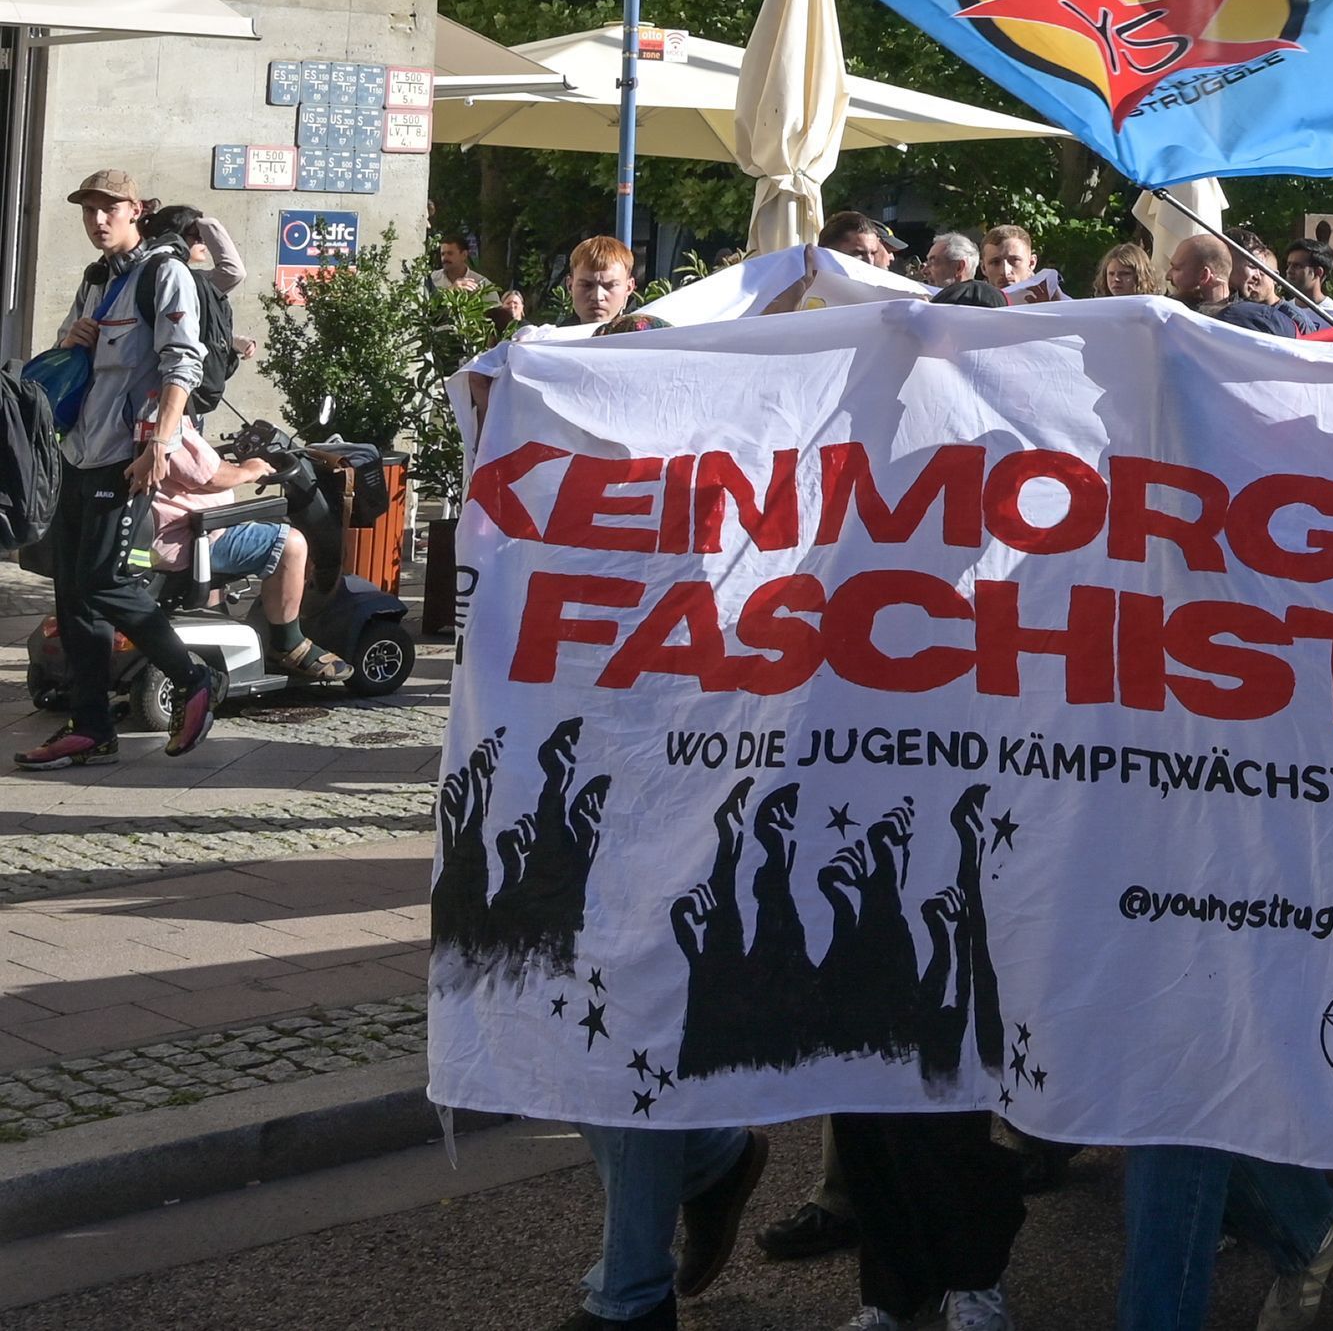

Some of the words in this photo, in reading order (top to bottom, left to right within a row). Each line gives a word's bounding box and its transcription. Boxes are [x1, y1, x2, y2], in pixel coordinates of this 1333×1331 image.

[1058, 0, 1193, 75] YS
[274, 70, 286, 80] ES
[304, 70, 317, 80] ES
[332, 72, 344, 82] ES
[359, 74, 366, 83] S
[392, 73, 399, 81] H
[405, 73, 422, 82] 500
[302, 113, 314, 123] US
[331, 114, 343, 125] US
[357, 116, 364, 126] S
[390, 116, 397, 124] H
[403, 115, 420, 124] 500
[253, 151, 260, 159] H
[265, 151, 283, 160] 500
[300, 156, 307, 165] K
[328, 157, 335, 167] S
[356, 159, 362, 168] S
[94, 490, 115, 499] JAKO
[667, 730, 729, 769] WO
[735, 730, 787, 769] DIE
[797, 727, 989, 770] JUGEND
